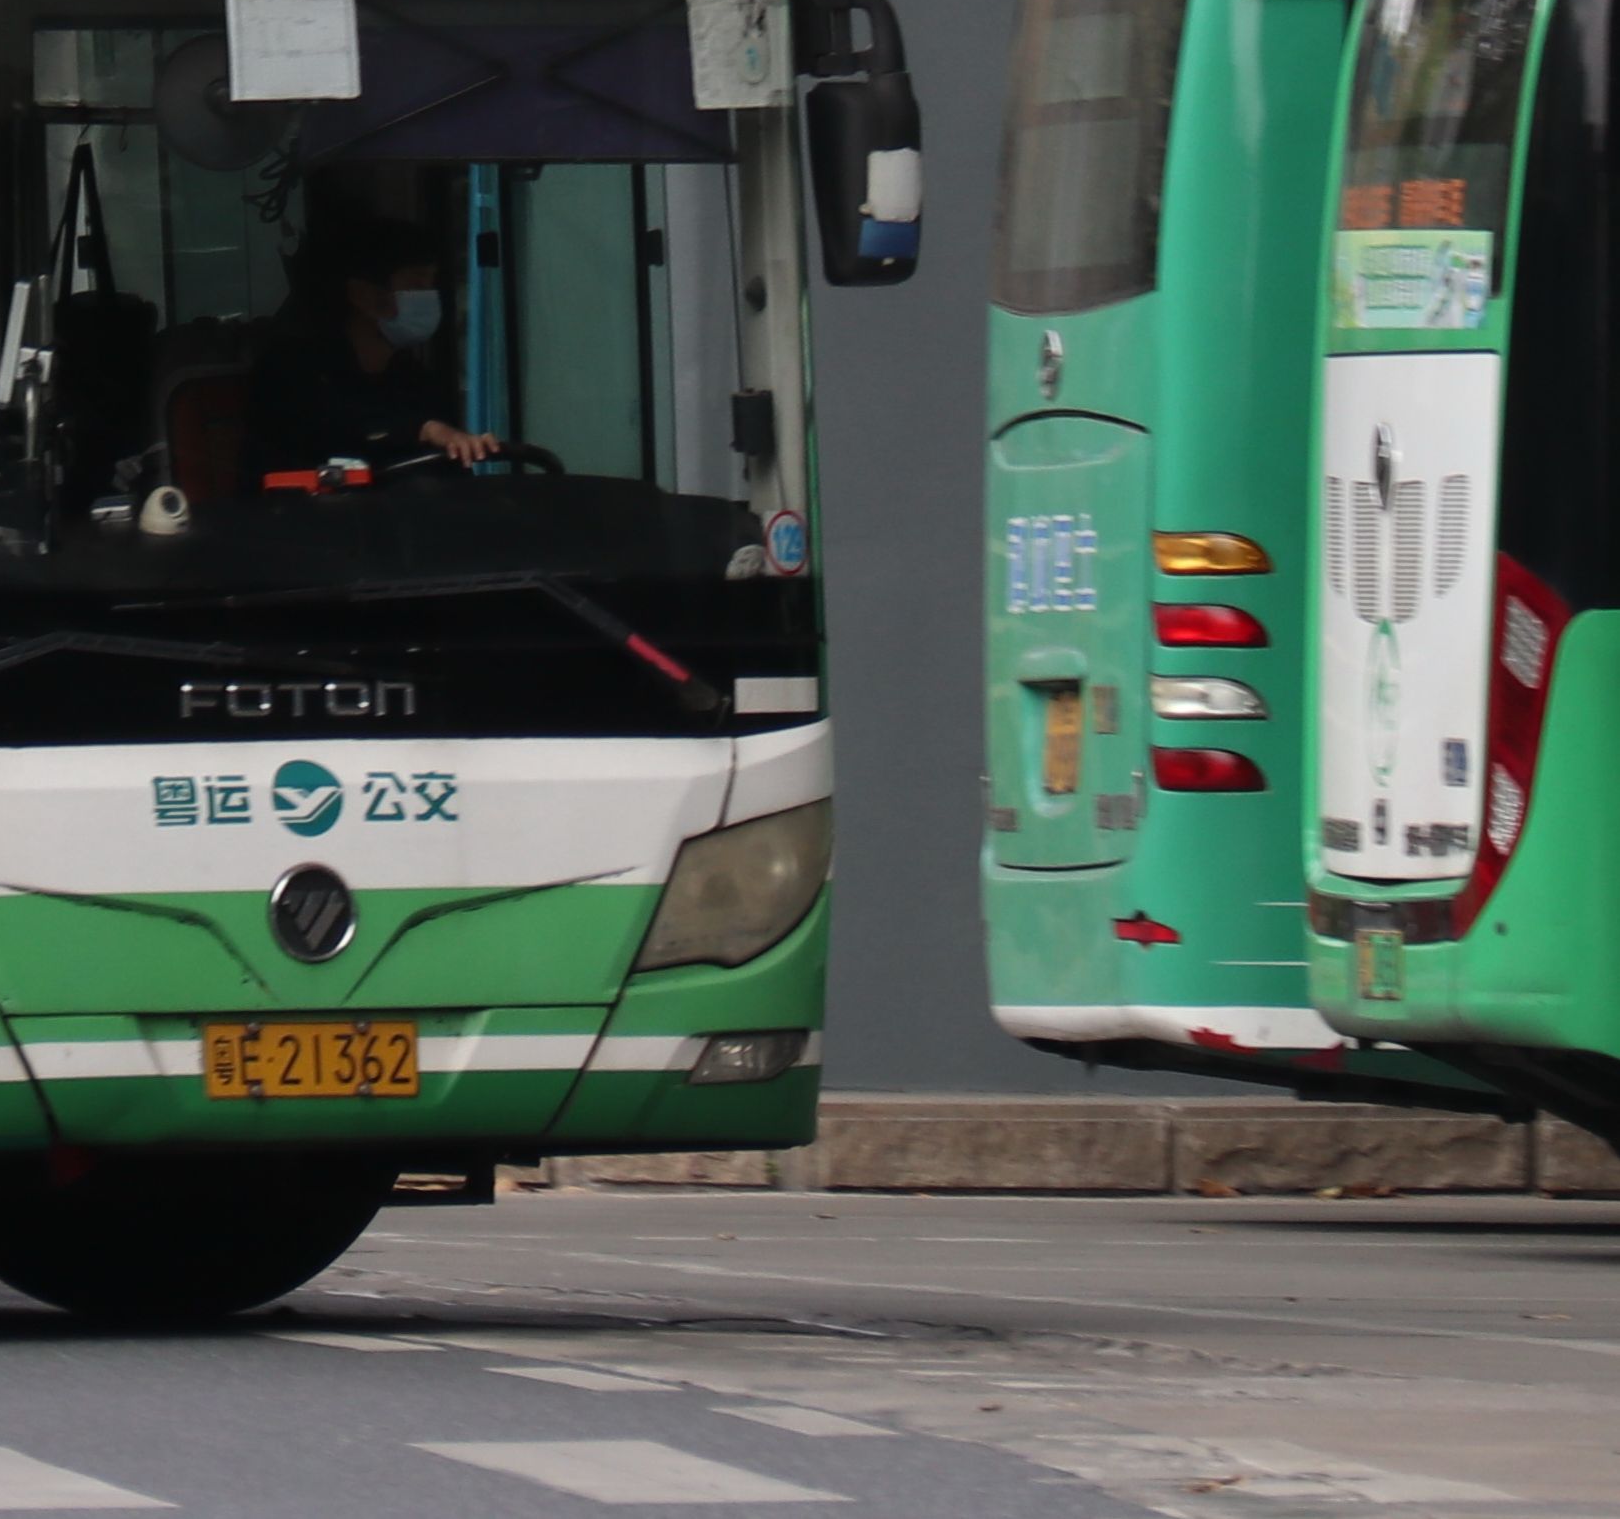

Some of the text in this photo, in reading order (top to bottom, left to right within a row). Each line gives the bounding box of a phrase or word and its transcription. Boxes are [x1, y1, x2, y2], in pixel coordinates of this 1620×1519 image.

[179, 681, 415, 718] FOTON
[152, 771, 459, 826] 粤运 公交
